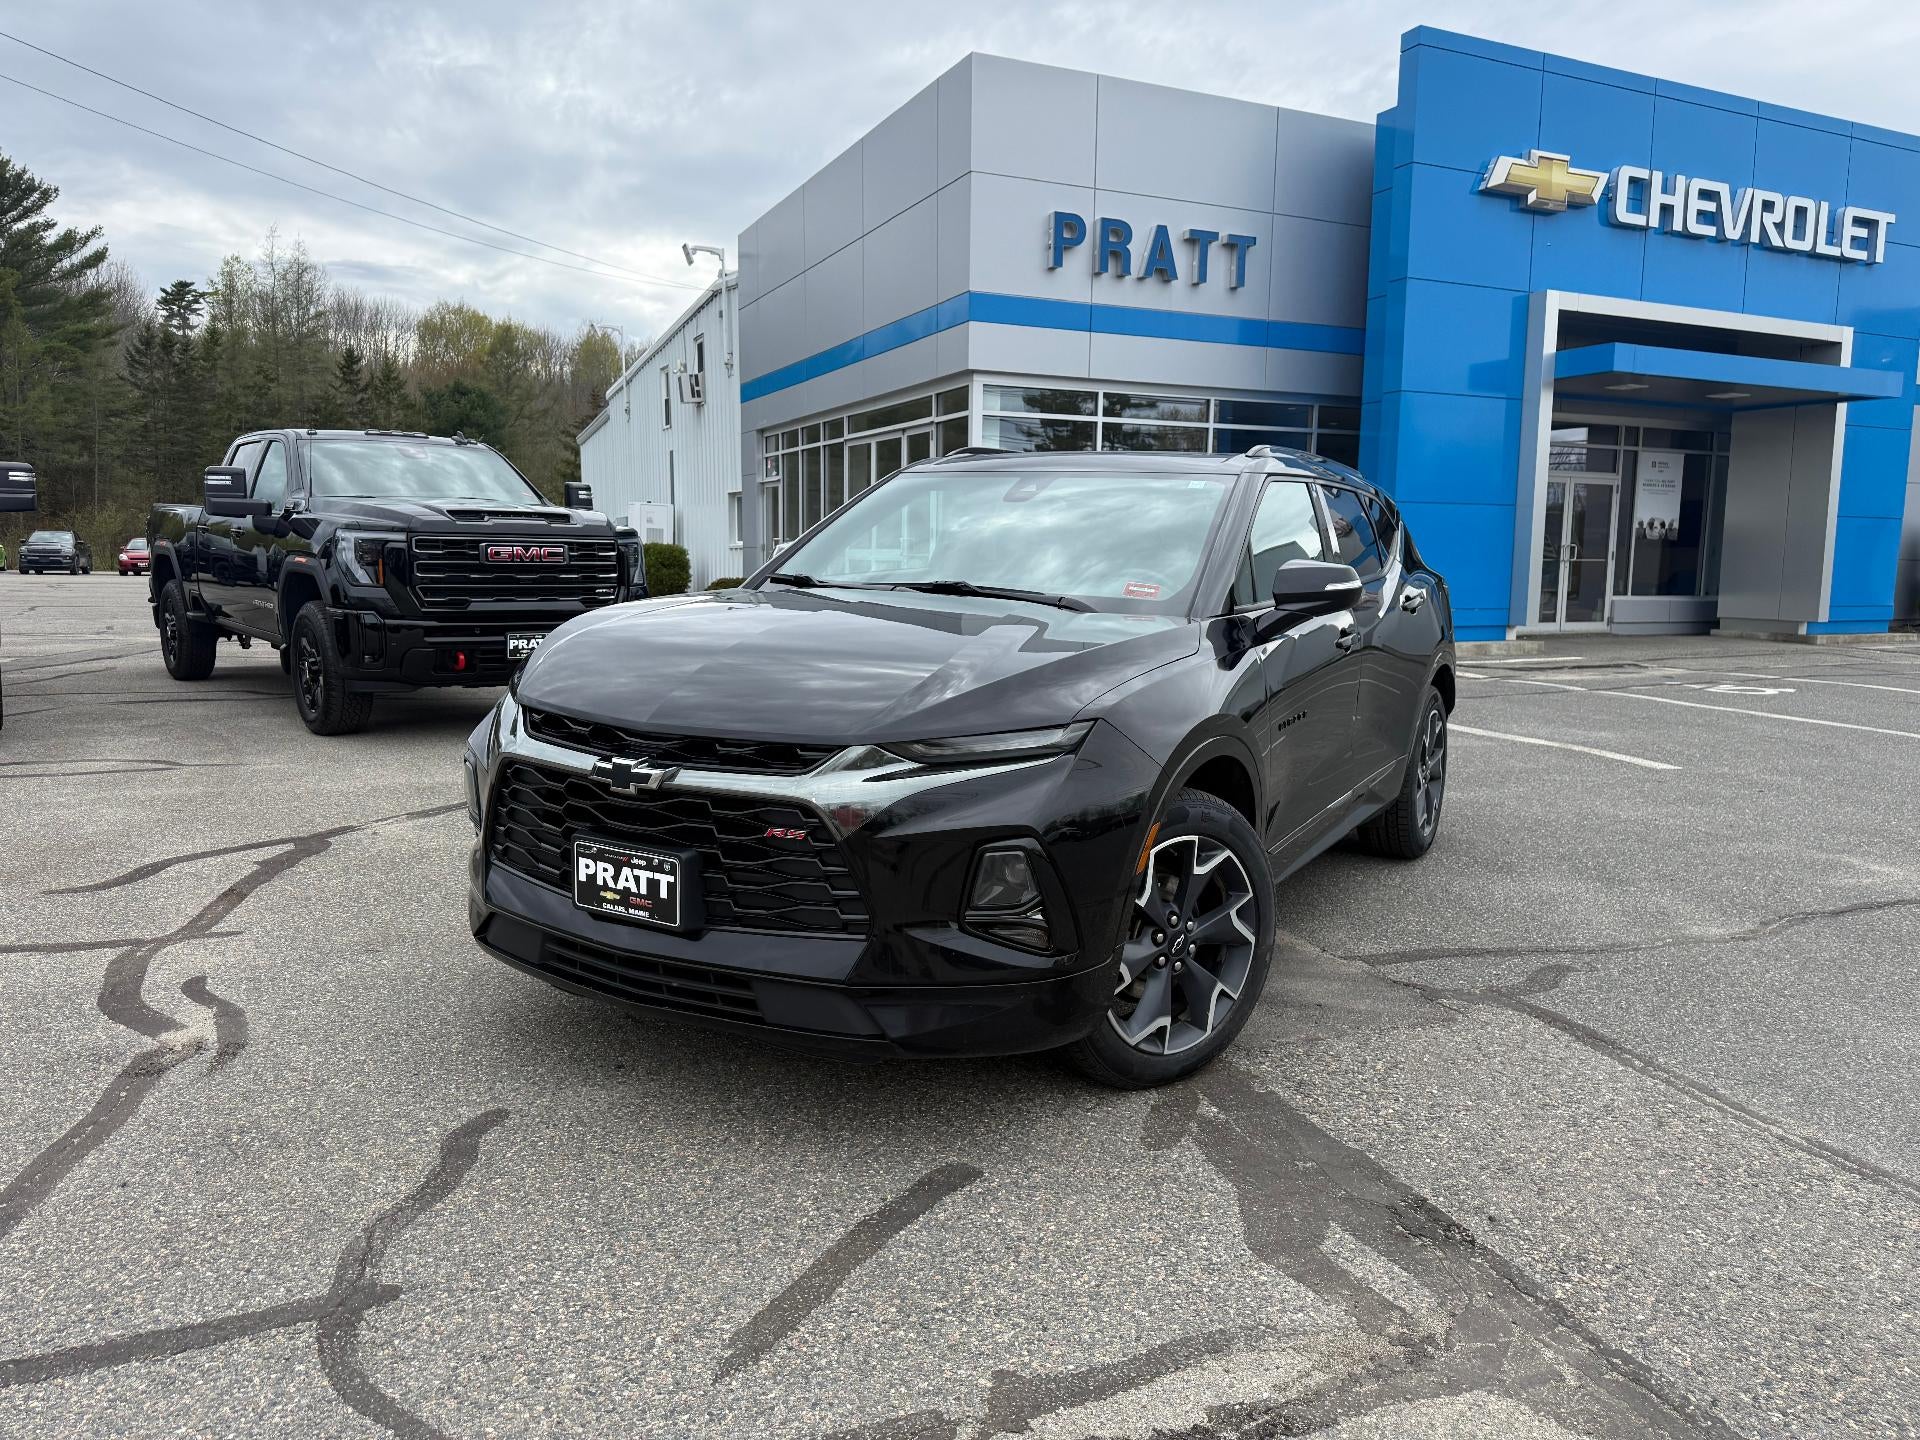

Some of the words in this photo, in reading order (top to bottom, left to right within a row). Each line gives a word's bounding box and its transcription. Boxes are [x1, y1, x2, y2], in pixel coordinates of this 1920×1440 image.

[1610, 164, 1896, 264] CHEVROLET
[1048, 211, 1257, 289] PRATT
[487, 546, 564, 562] GMC
[763, 828, 806, 840] RS
[630, 856, 647, 867] Jeep
[578, 856, 675, 900] PRATT
[629, 896, 653, 908] GMC
